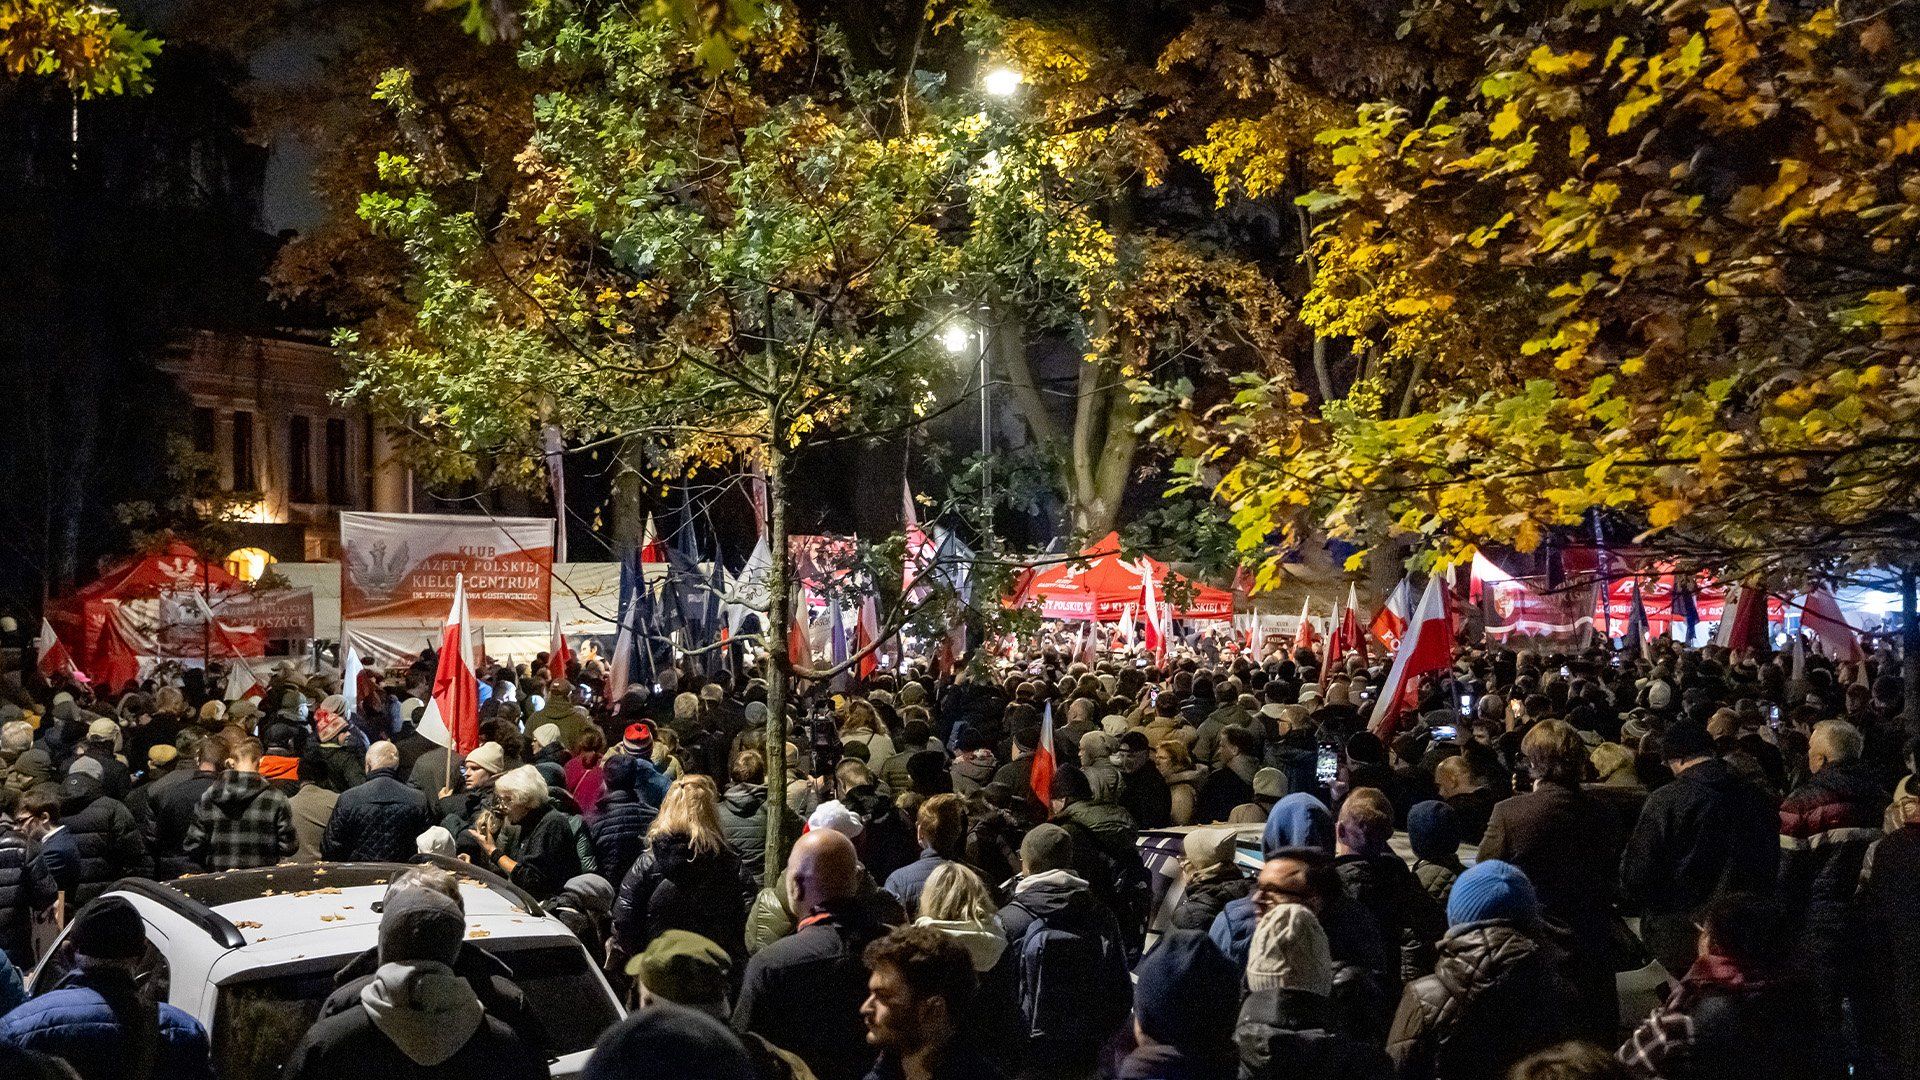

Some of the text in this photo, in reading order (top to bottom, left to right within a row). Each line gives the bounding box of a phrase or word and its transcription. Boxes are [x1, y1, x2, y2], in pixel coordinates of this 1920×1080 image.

[459, 545, 496, 557] KLUB
[415, 560, 539, 574] AZETY POLSKIEJ
[412, 575, 540, 588] KIELC-CENTRUM
[425, 591, 480, 599] PRZEMYAWA
[1112, 602, 1140, 611] KLBY
[229, 615, 306, 627] ATOSZYCE
